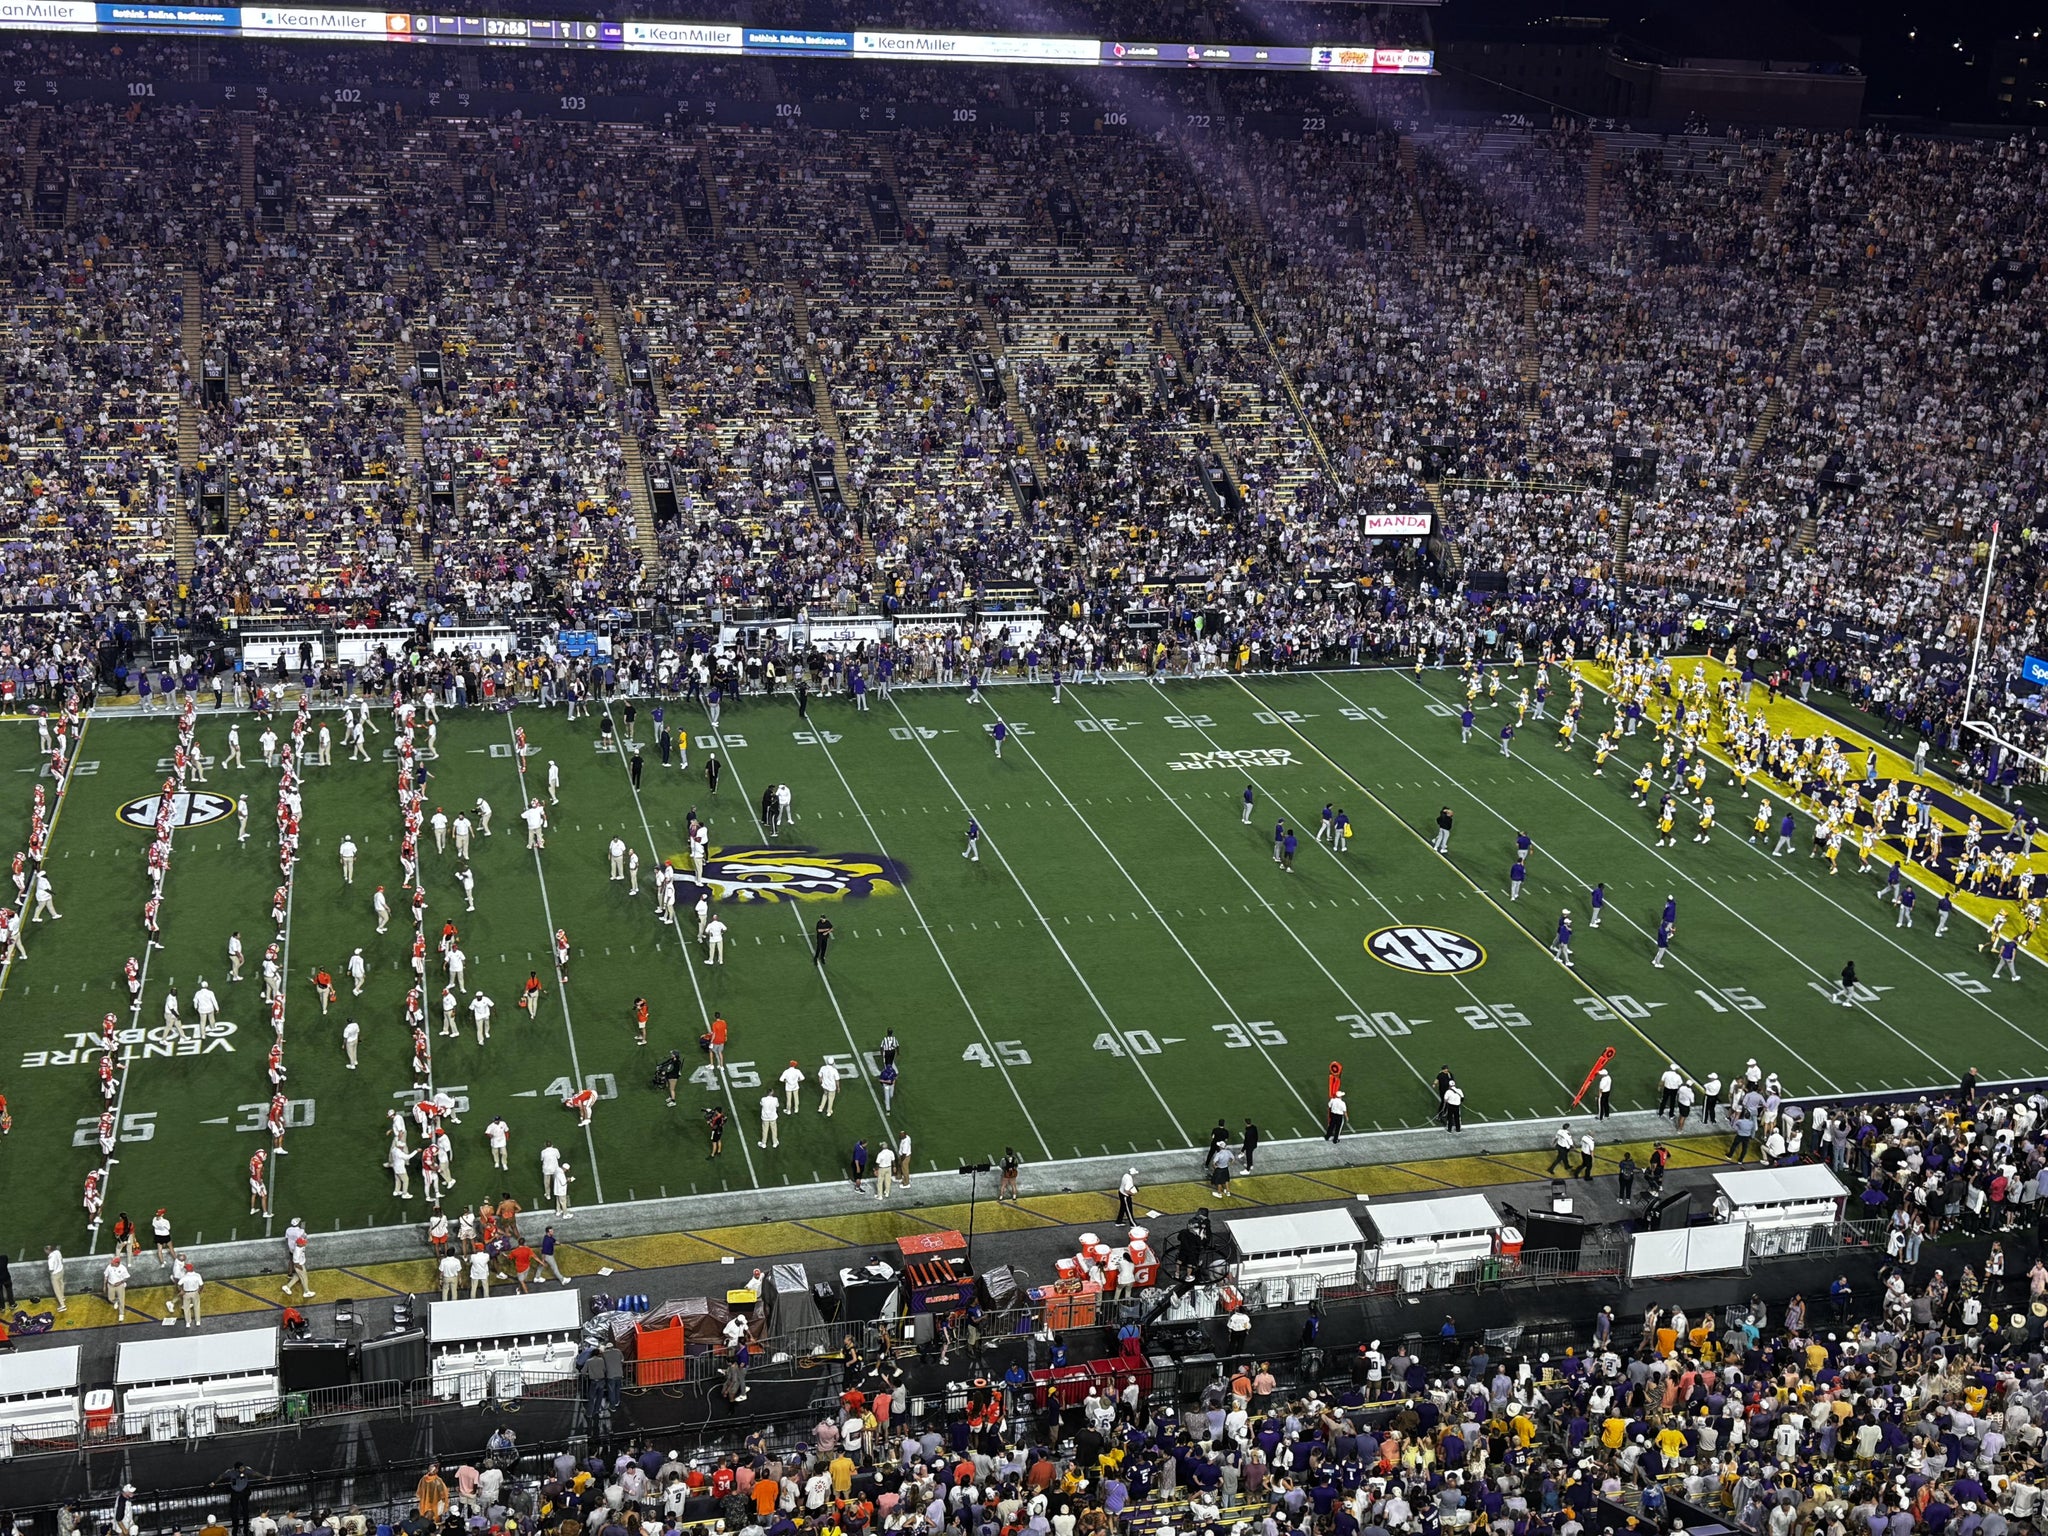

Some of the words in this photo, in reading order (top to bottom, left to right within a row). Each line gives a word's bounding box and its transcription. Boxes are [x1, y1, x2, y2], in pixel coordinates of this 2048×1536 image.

[0, 4, 74, 17] anMiller
[416, 18, 427, 31] 0
[585, 25, 596, 38] 0
[127, 82, 156, 97] 101
[334, 89, 361, 102] 102
[560, 97, 586, 110] 103
[776, 104, 802, 117] 104
[952, 109, 977, 121] 105
[1103, 112, 1127, 125] 106
[1187, 115, 1211, 128] 222
[1302, 118, 1326, 130] 223
[1369, 516, 1427, 529] MANDA
[271, 647, 296, 656] LSU
[1163, 714, 1217, 728] 25
[1252, 710, 1306, 724] 20
[1074, 718, 1127, 733] 30
[792, 730, 843, 745] 45
[888, 726, 938, 741] 40
[694, 734, 748, 749] 50
[1180, 749, 1292, 761] GLOBAL
[1166, 757, 1303, 771] VENTURE
[1373, 928, 1478, 971] SEC
[1943, 971, 1993, 994] 5
[1694, 987, 1767, 1013] 15
[1573, 994, 1651, 1021] 20
[1455, 1003, 1532, 1030] 25
[1335, 1011, 1412, 1039] 30
[1211, 1020, 1289, 1048] 35
[1092, 1029, 1162, 1057] 40
[962, 1040, 1033, 1068] 45
[689, 1061, 762, 1091] 45
[543, 1072, 618, 1103] 40
[72, 1111, 158, 1147] 25
[1135, 1267, 1149, 1283] G
[718, 1480, 730, 1491] 34
[1141, 1473, 1148, 1484] 5
[675, 1492, 682, 1504] 9
